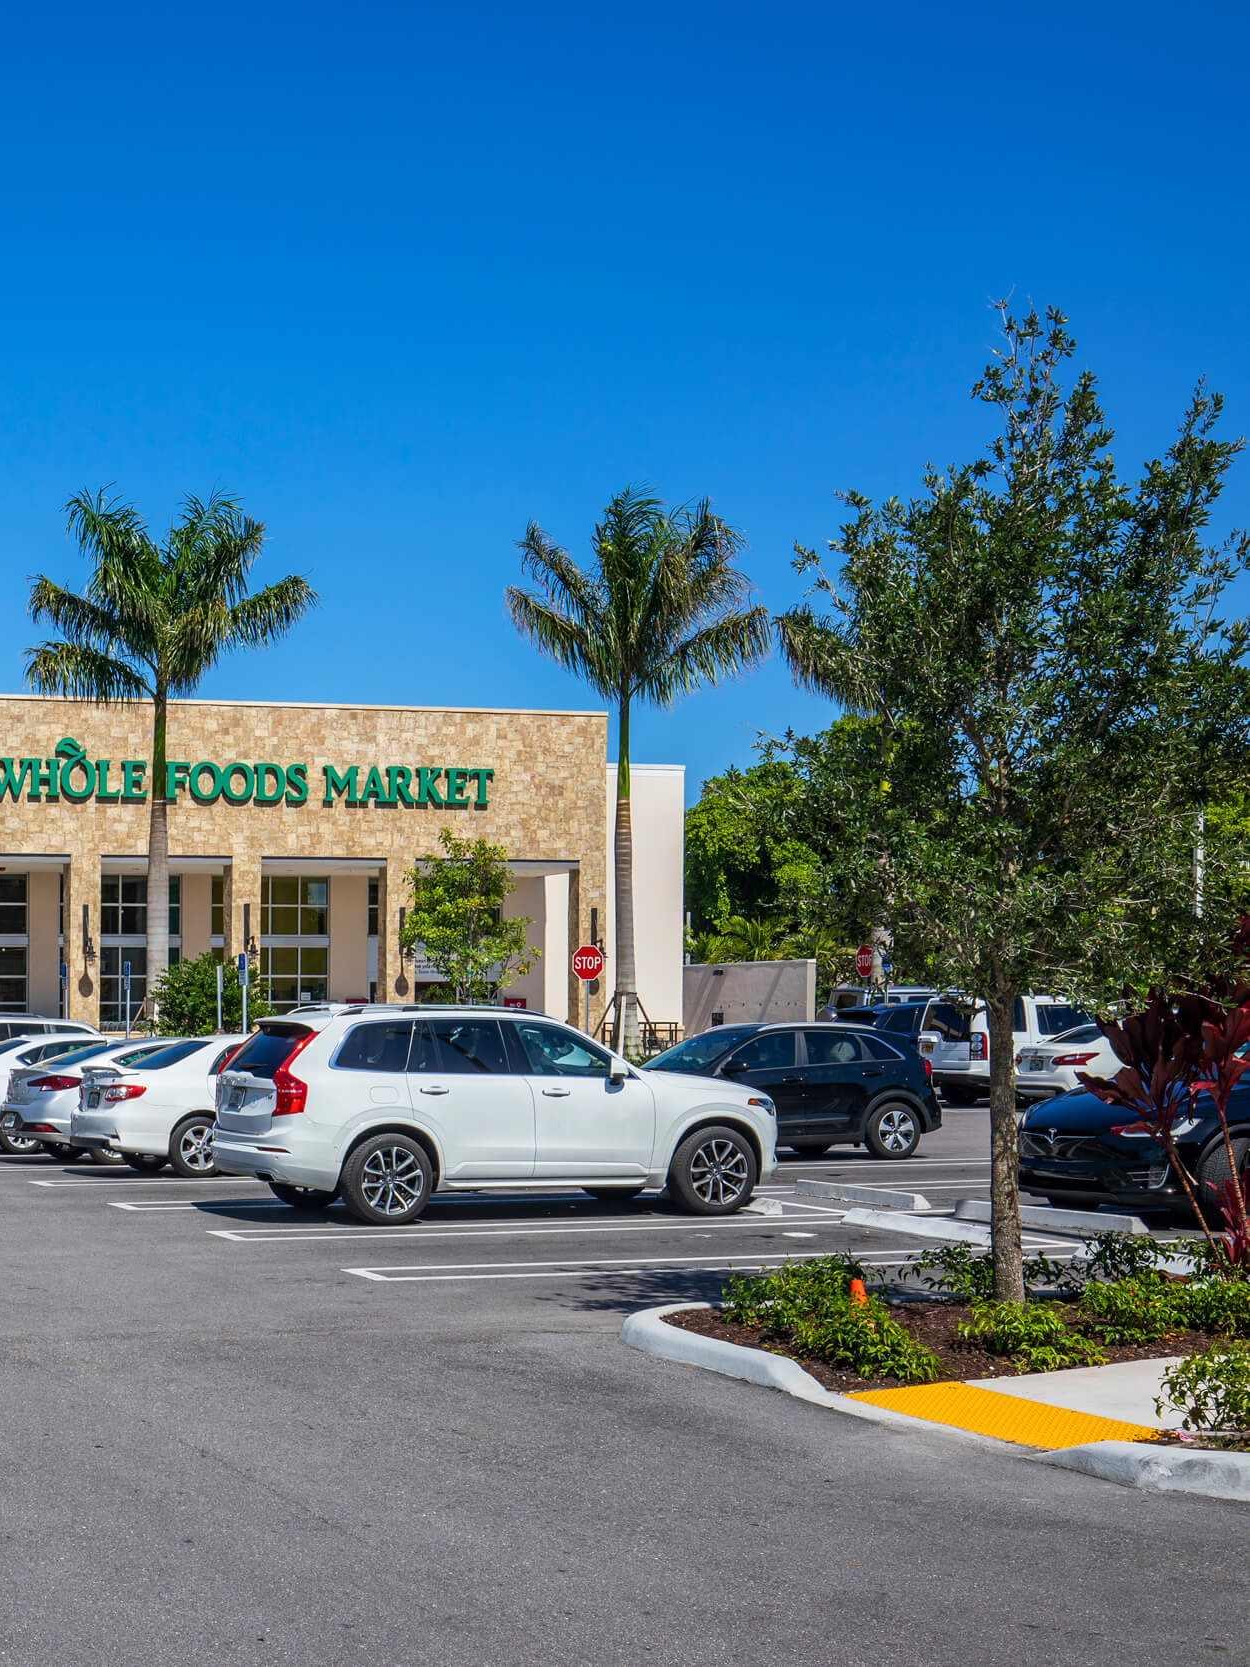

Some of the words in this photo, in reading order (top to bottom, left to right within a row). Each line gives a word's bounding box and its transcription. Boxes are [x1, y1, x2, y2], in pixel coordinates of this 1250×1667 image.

[166, 761, 309, 801] FOODS
[323, 765, 495, 804] MARKET
[575, 956, 601, 969] STOP
